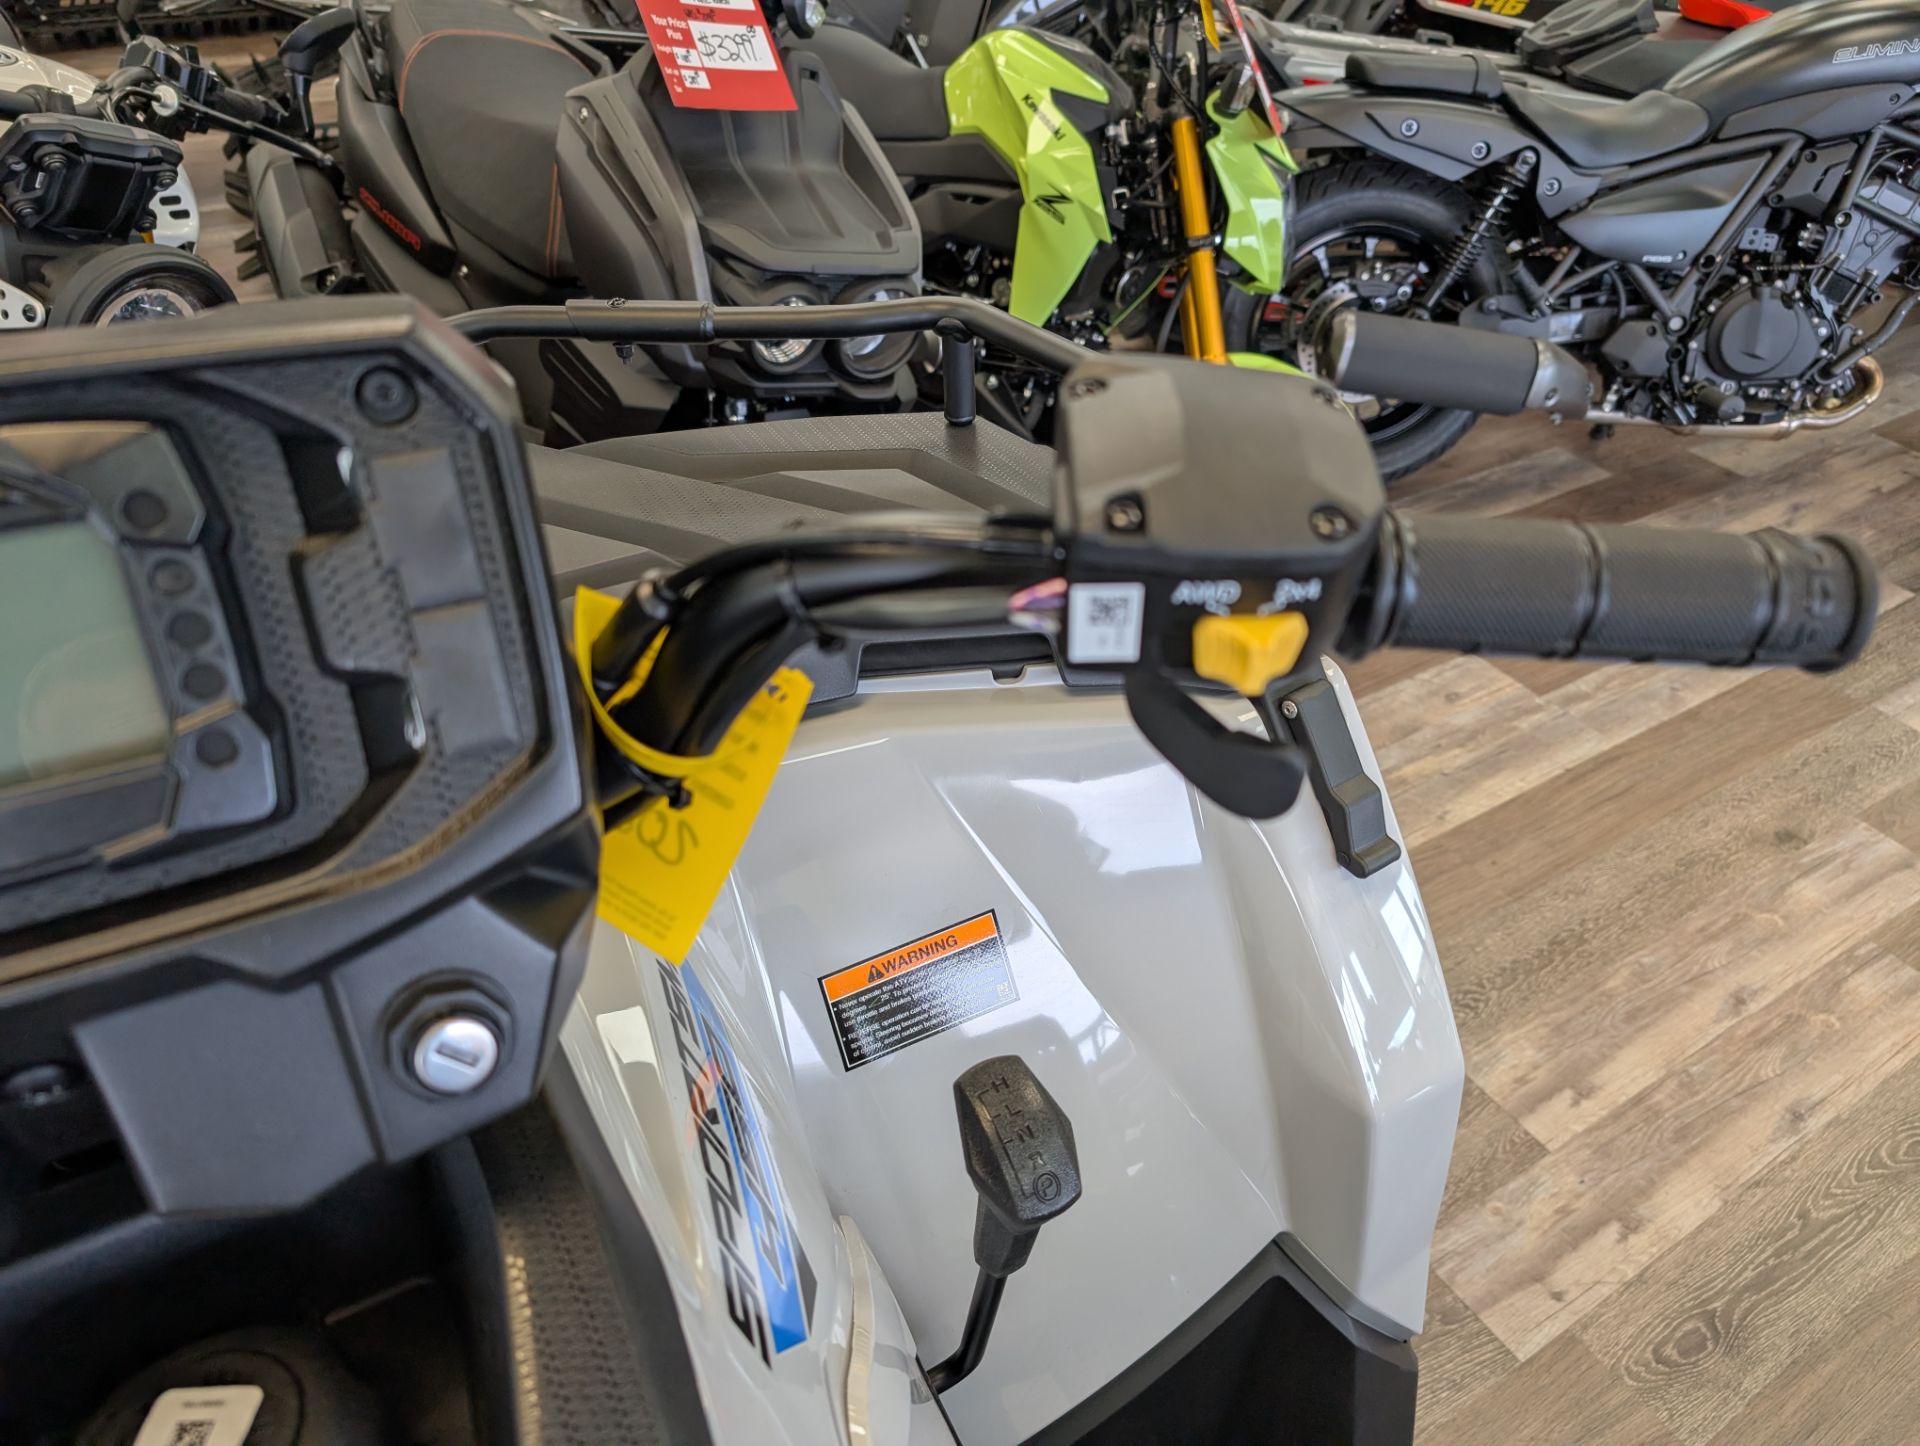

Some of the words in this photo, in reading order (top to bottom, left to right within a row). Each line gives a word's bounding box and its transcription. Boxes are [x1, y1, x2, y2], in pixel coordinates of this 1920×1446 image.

[1833, 38, 1920, 64] ELIMIN
[881, 935, 958, 974] WARNING
[859, 989, 881, 1002] operate
[894, 977, 908, 988] ATV
[879, 1004, 890, 1012] and
[891, 997, 912, 1008] brakes
[848, 1025, 880, 1040] REVERSE
[881, 1011, 910, 1027] operation
[875, 1024, 901, 1038] Steering
[991, 1076, 1009, 1093] H
[1005, 1104, 1022, 1117] L
[1016, 1123, 1034, 1143] N
[1028, 1151, 1046, 1170] R
[1041, 1177, 1053, 1197] P
